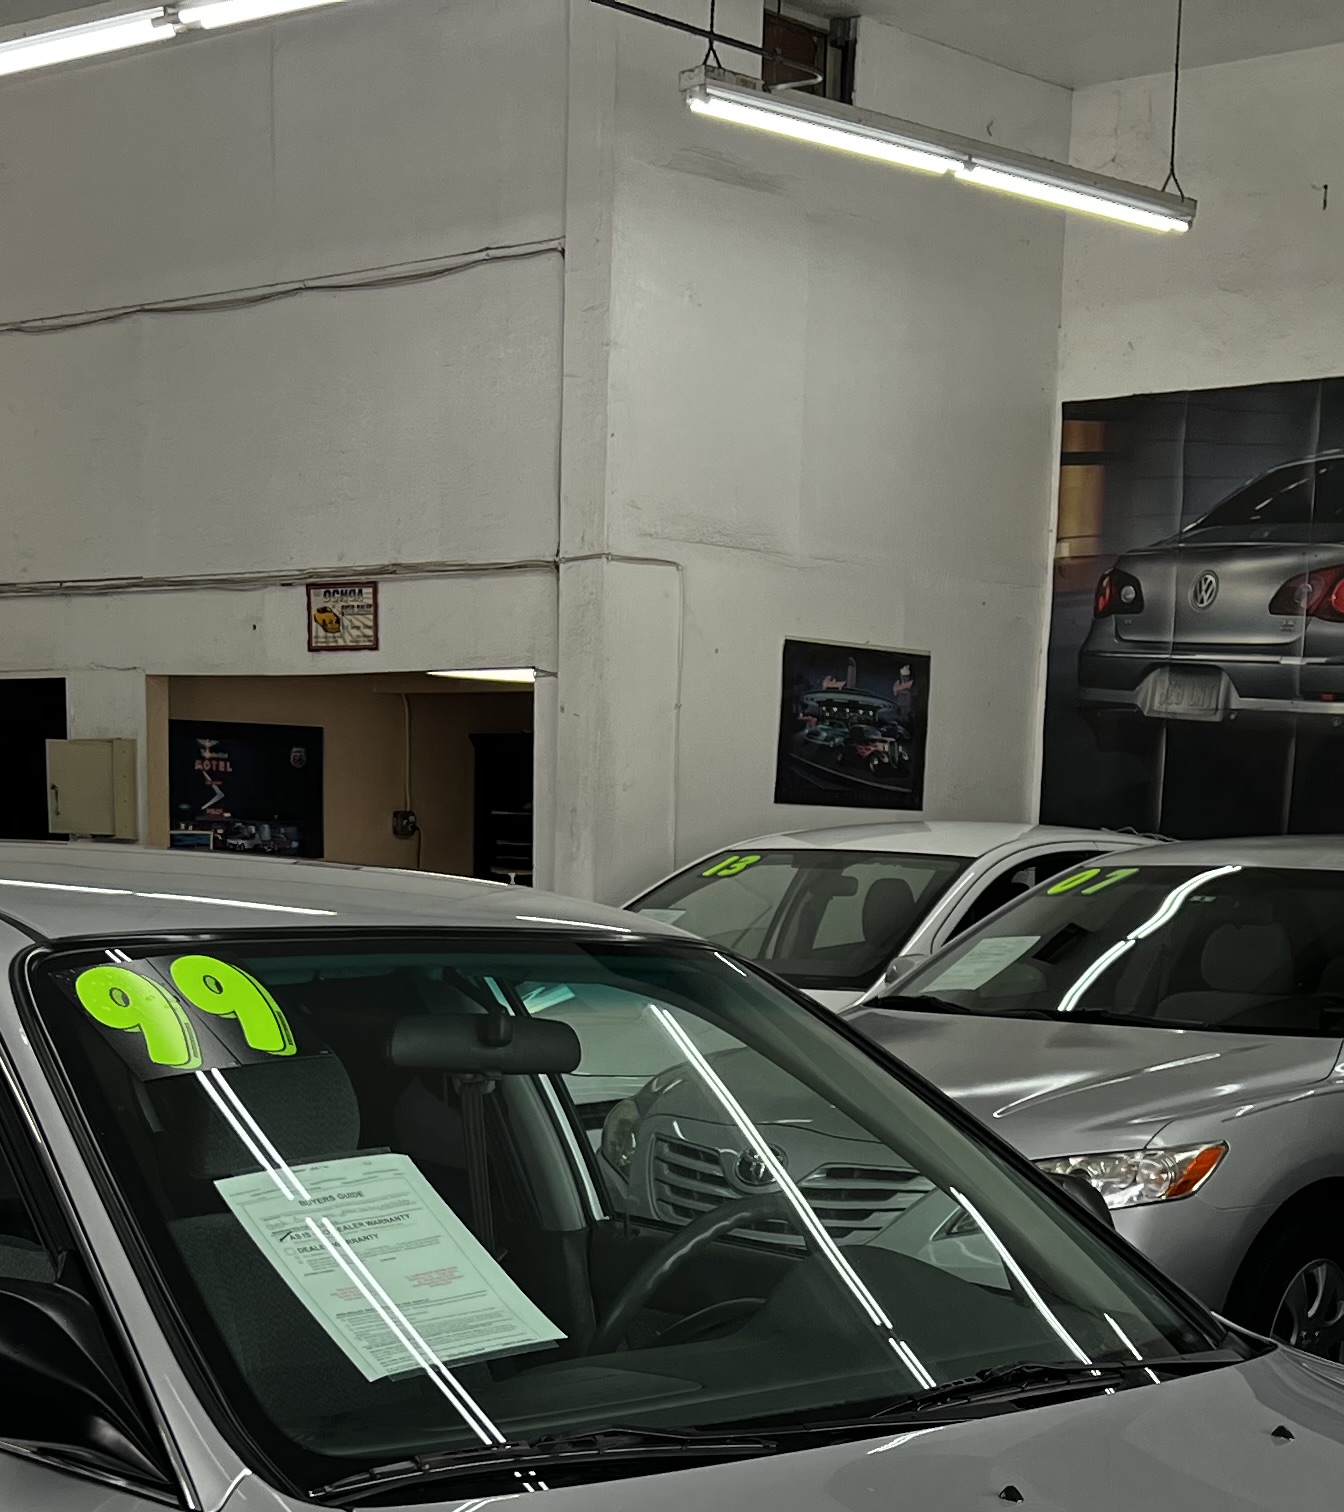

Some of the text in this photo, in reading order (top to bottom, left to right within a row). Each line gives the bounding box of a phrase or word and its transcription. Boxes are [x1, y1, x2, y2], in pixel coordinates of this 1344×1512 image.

[702, 855, 761, 877] 13
[75, 955, 297, 1070] 99
[298, 1194, 336, 1206] BUYERS
[337, 1190, 364, 1200] GUIDE
[332, 1221, 365, 1233] EALER
[365, 1213, 410, 1226] WARRANTY
[332, 1233, 379, 1248] WRRANTY
